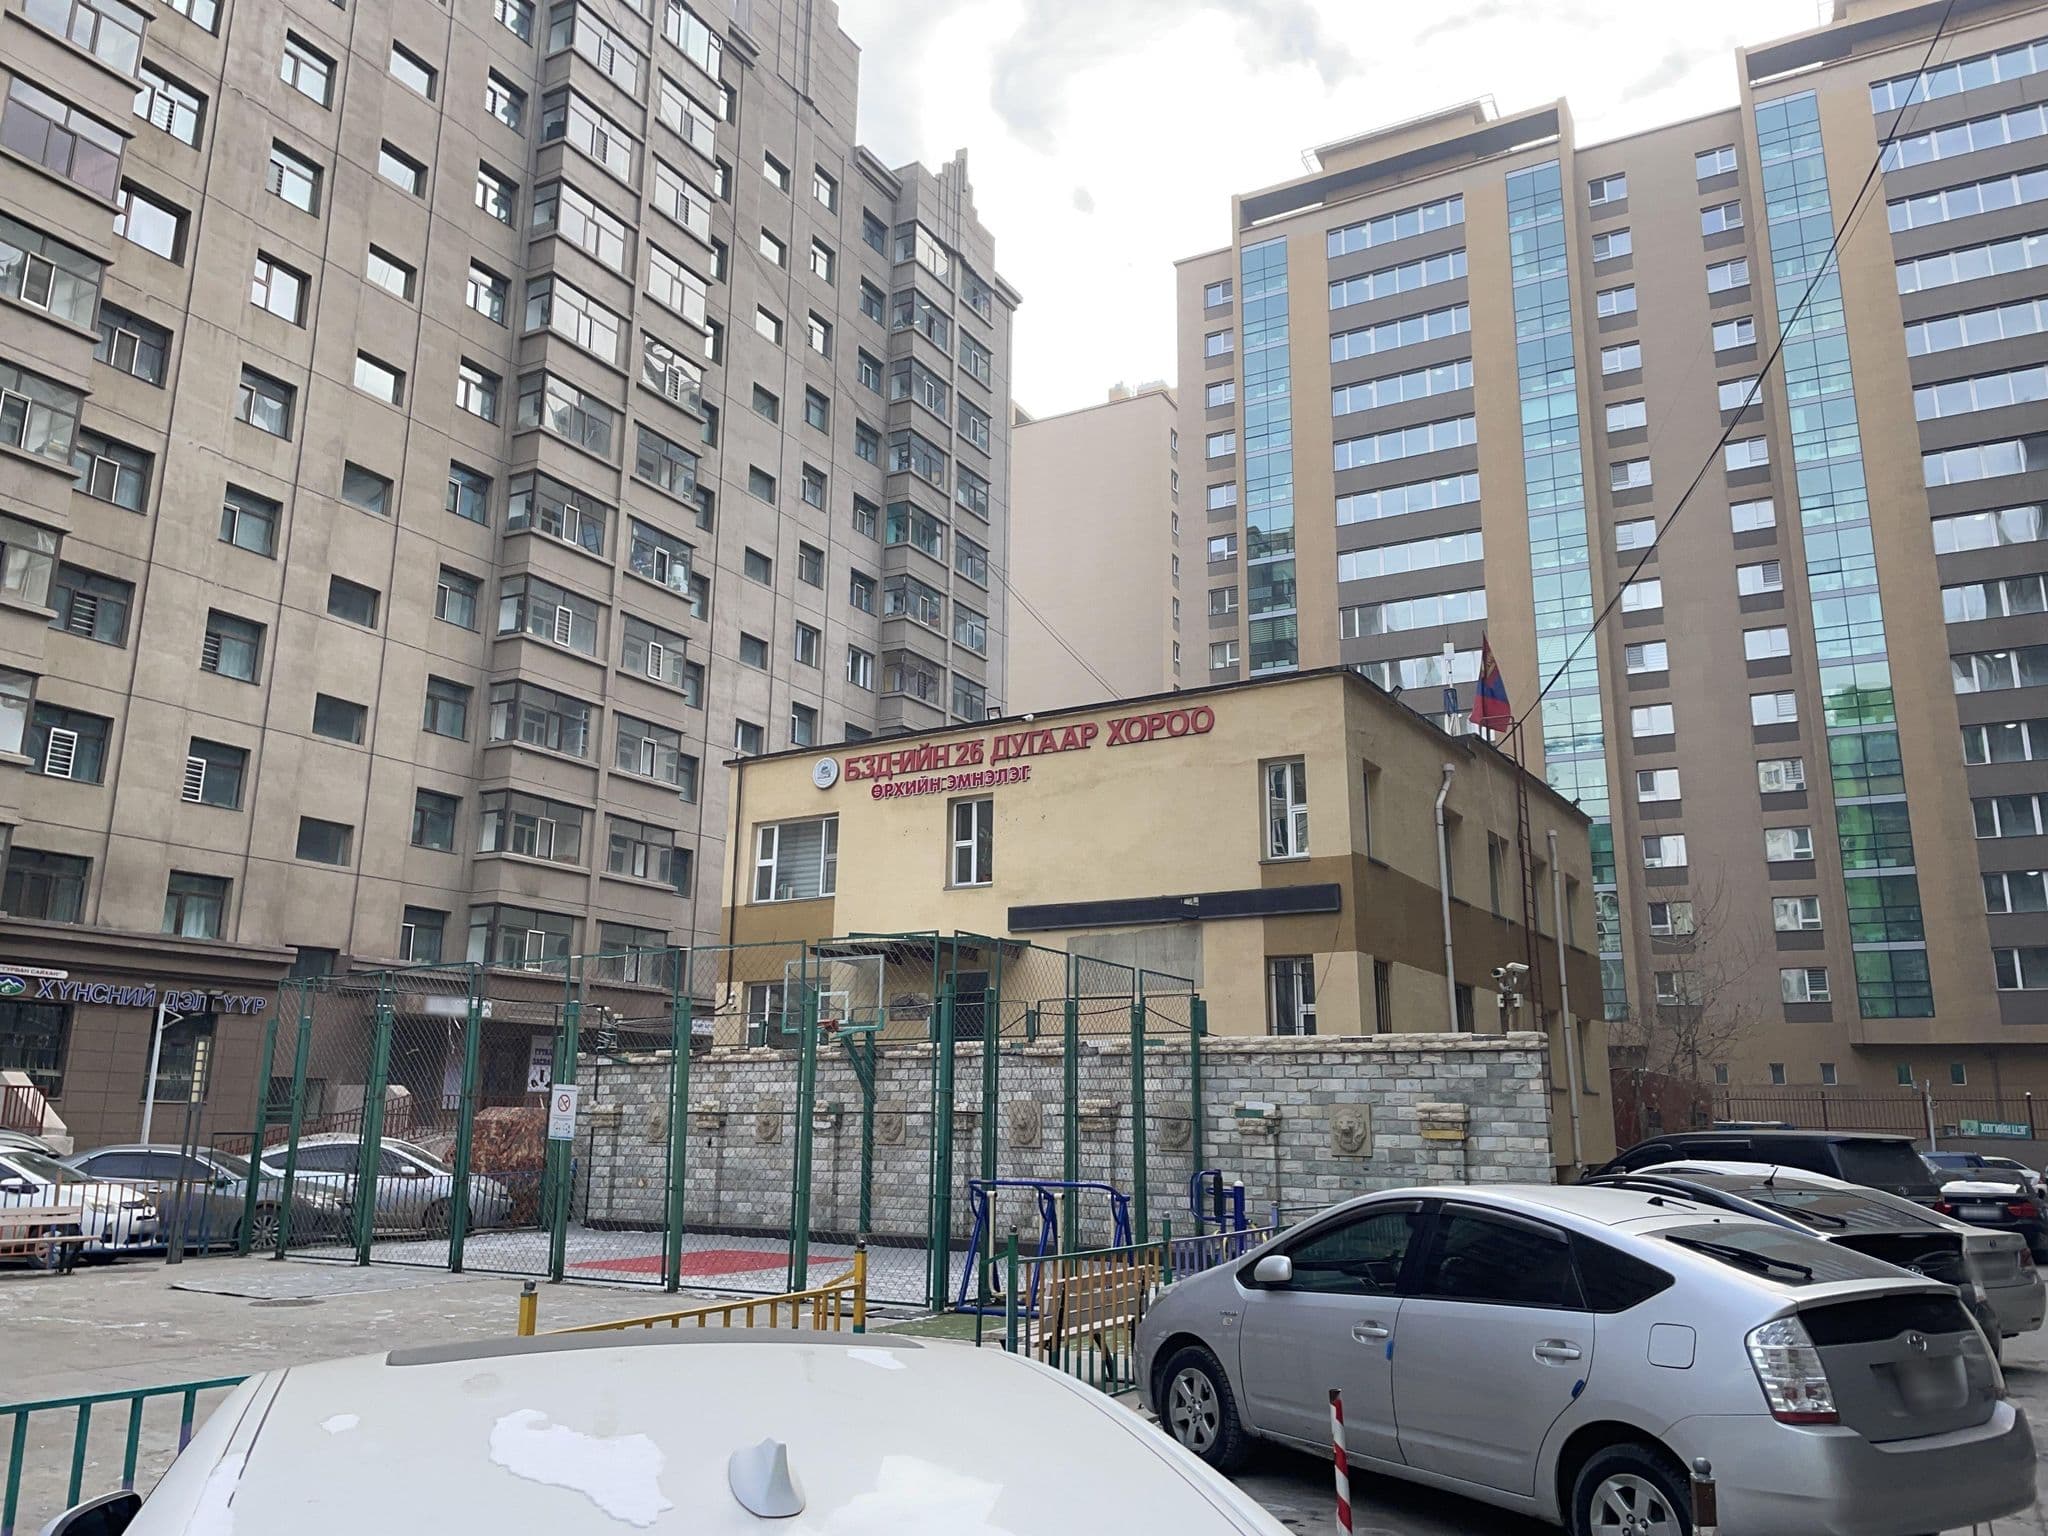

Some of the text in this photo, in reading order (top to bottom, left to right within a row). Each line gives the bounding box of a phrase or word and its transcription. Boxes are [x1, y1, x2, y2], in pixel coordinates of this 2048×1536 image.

[844, 706, 1215, 782] БЗД-ИЙН 26 ДУГААР ХОРОО
[871, 765, 1032, 800] ӨРХИЙН ЭМНЭЛЭГ
